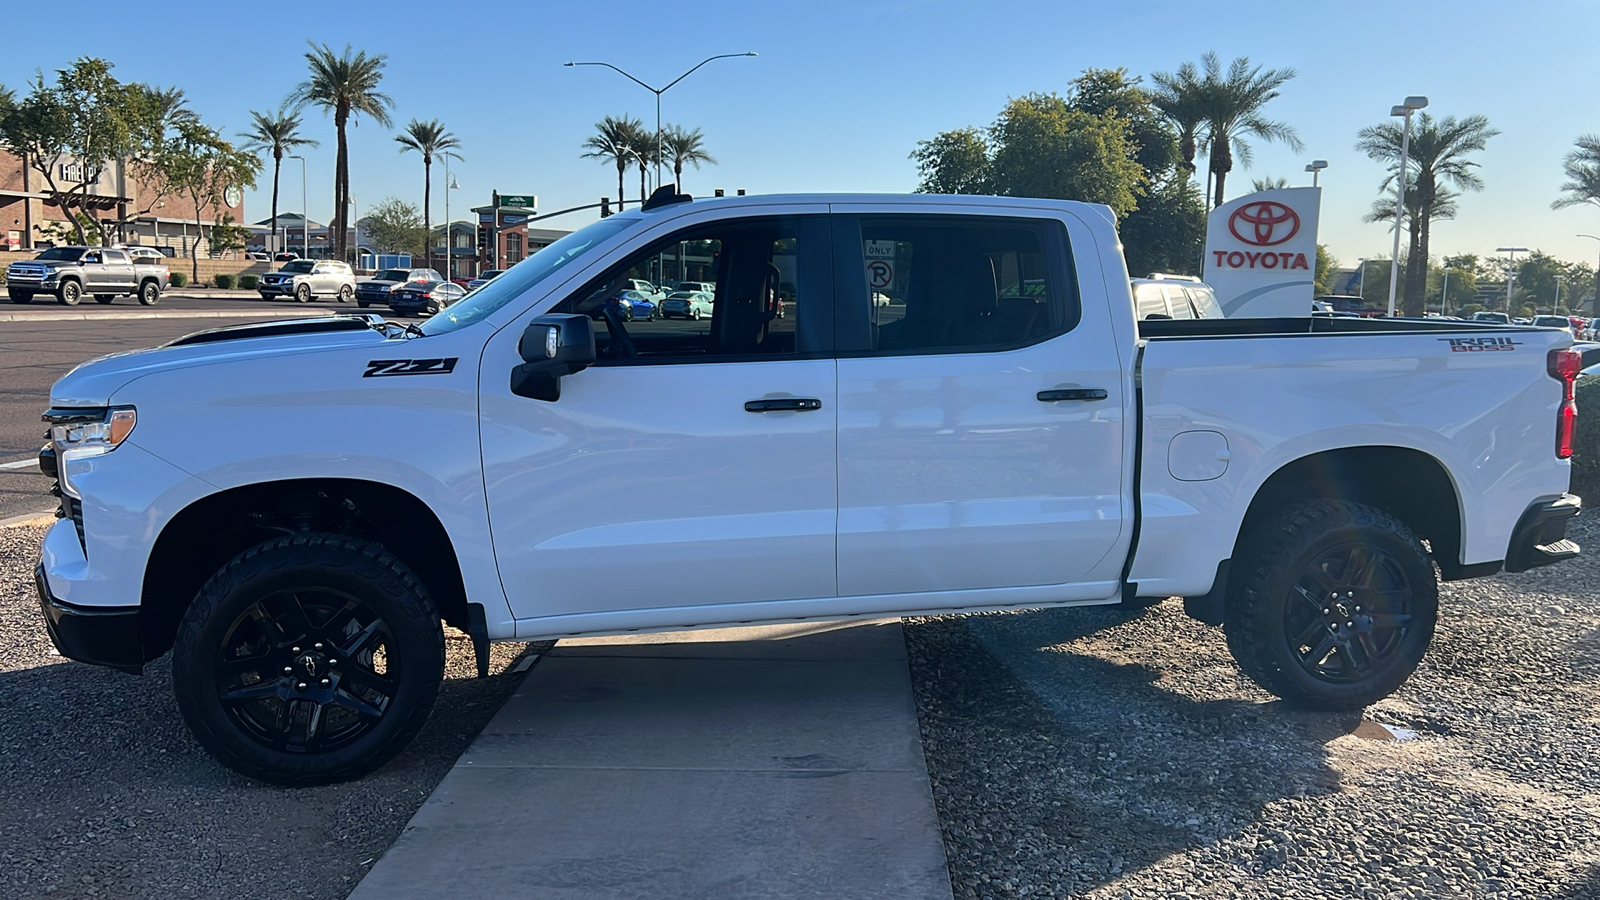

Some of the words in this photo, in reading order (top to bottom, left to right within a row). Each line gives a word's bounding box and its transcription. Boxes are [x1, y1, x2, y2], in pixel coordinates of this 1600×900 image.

[1213, 251, 1309, 270] TOYOTA
[1437, 337, 1523, 345] TRAIL
[362, 357, 459, 378] Z71
